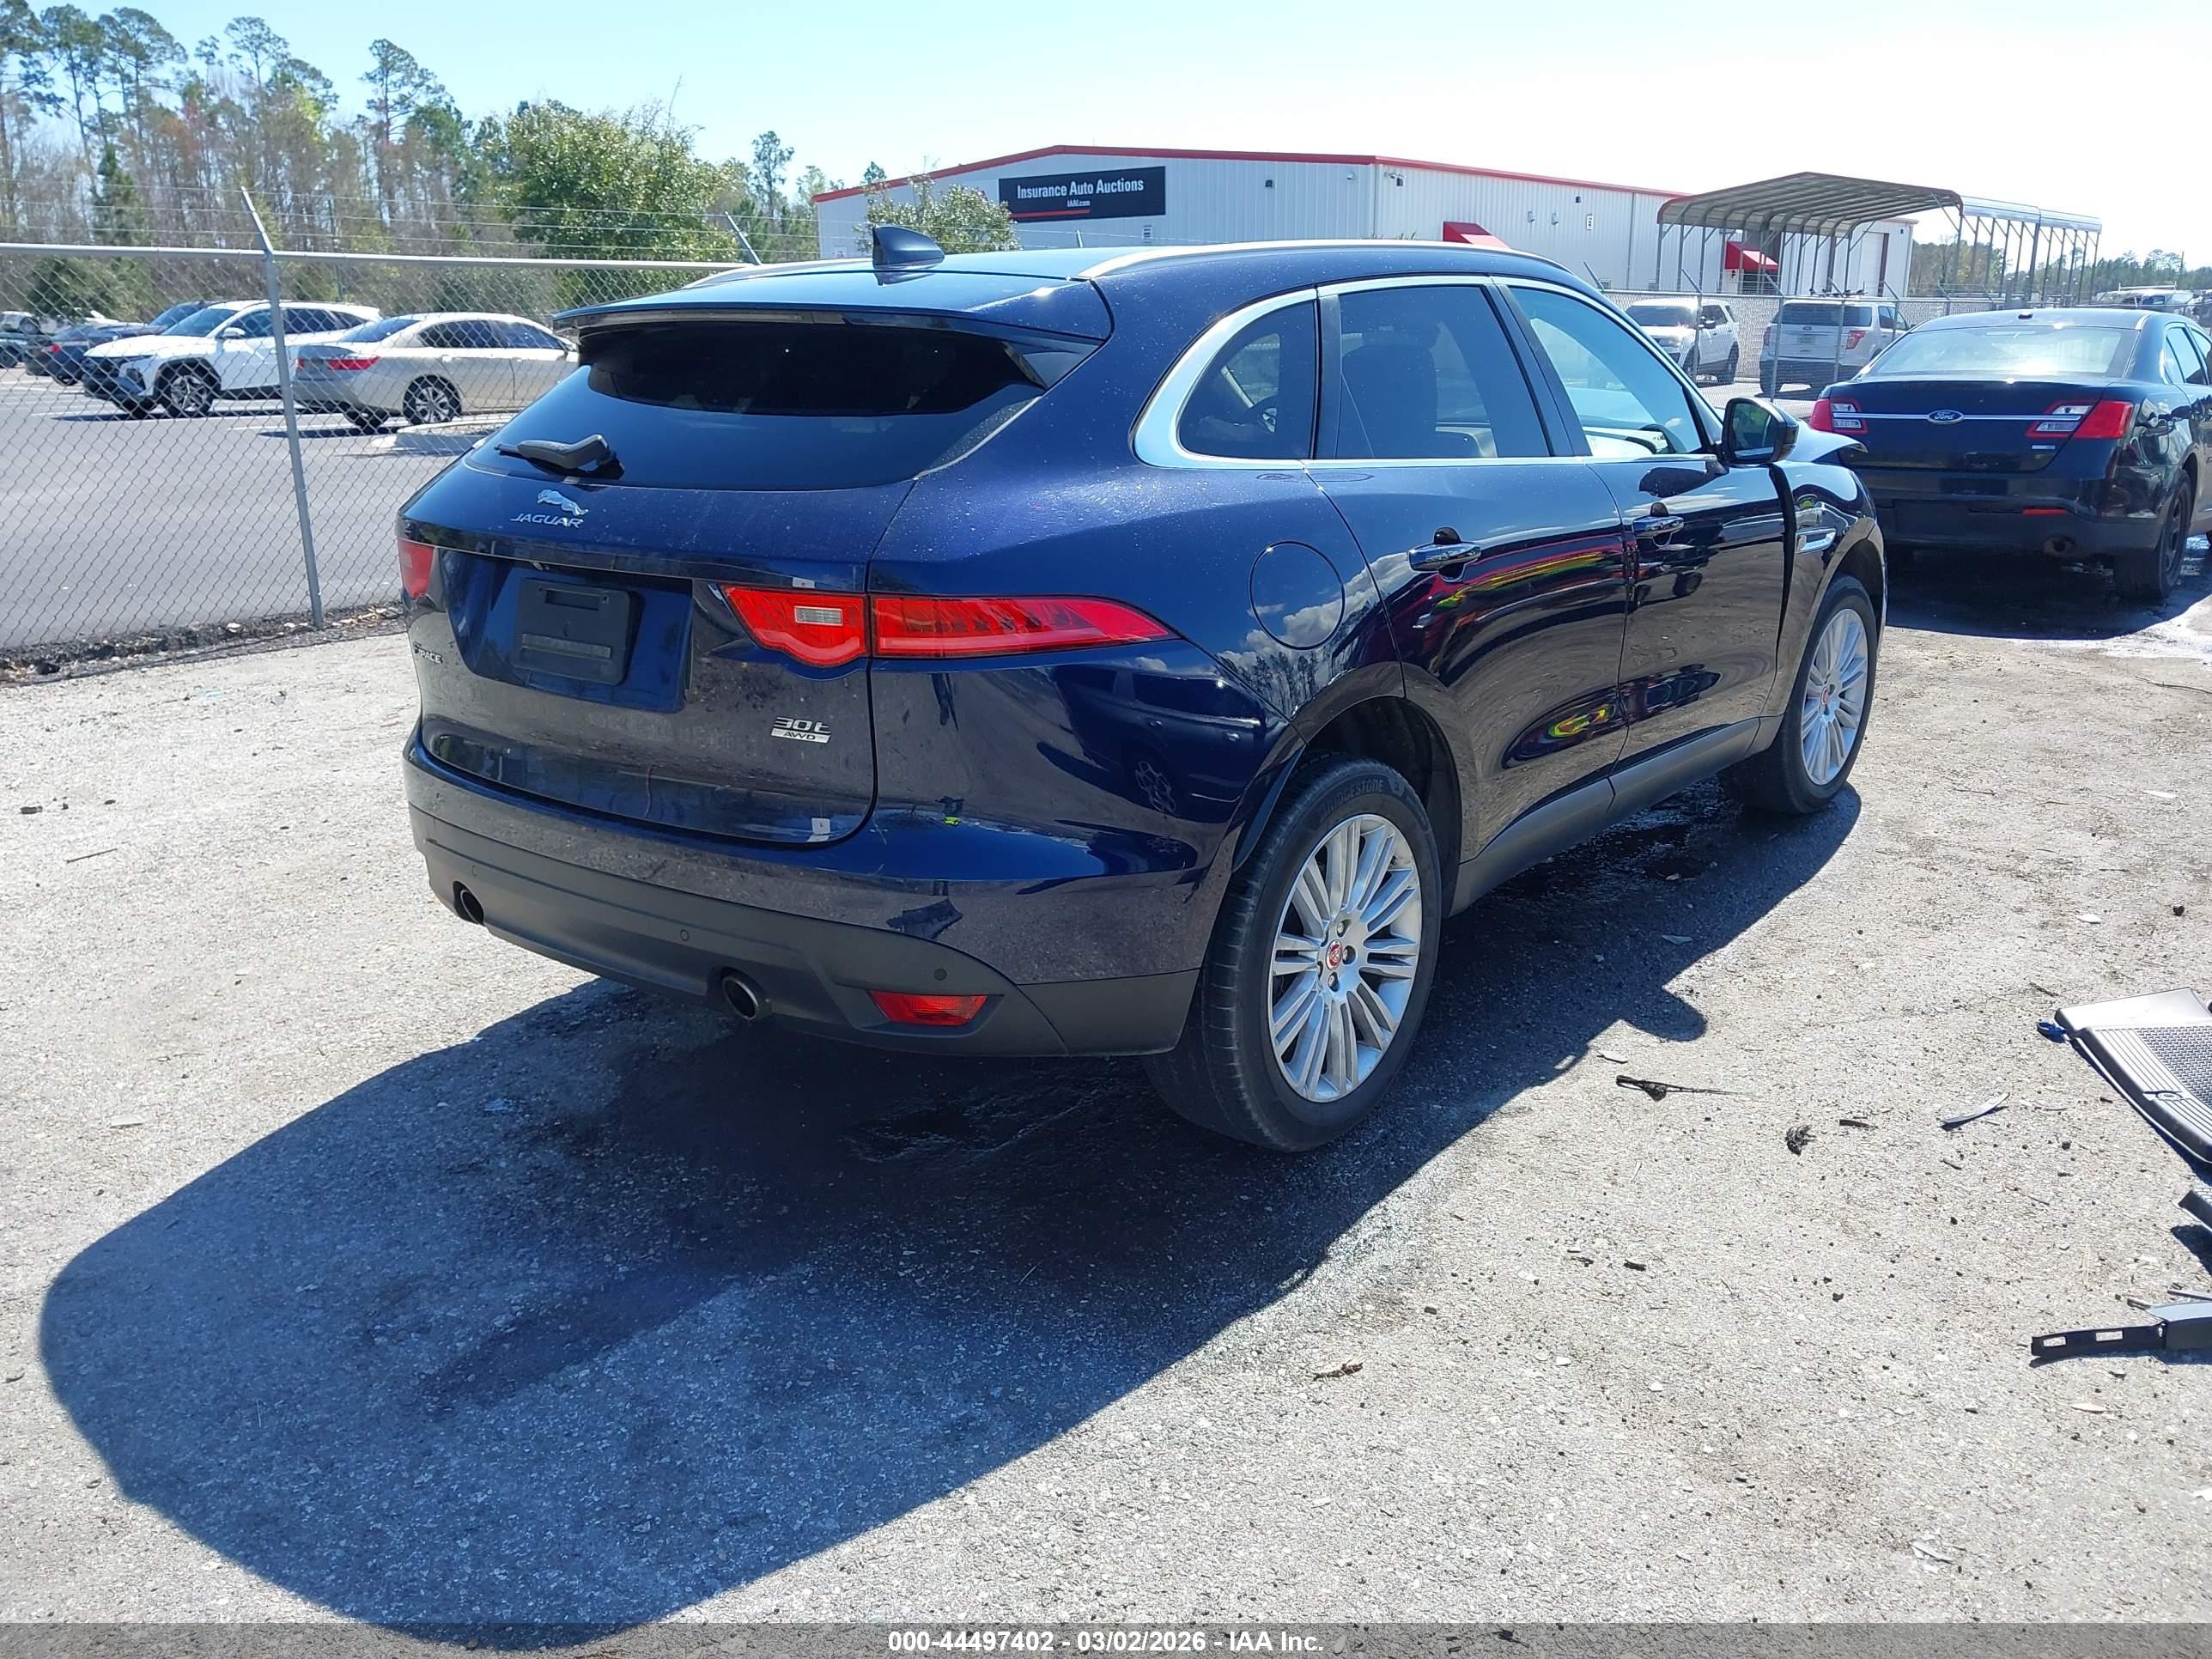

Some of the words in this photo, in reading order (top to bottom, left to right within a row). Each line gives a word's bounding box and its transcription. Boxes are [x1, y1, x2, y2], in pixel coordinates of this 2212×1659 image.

[1017, 185, 1067, 199] Insurance
[1069, 180, 1094, 196] Auto
[1096, 178, 1144, 194] Auctions
[508, 513, 584, 529] JAGUAR
[783, 732, 816, 740] AWD
